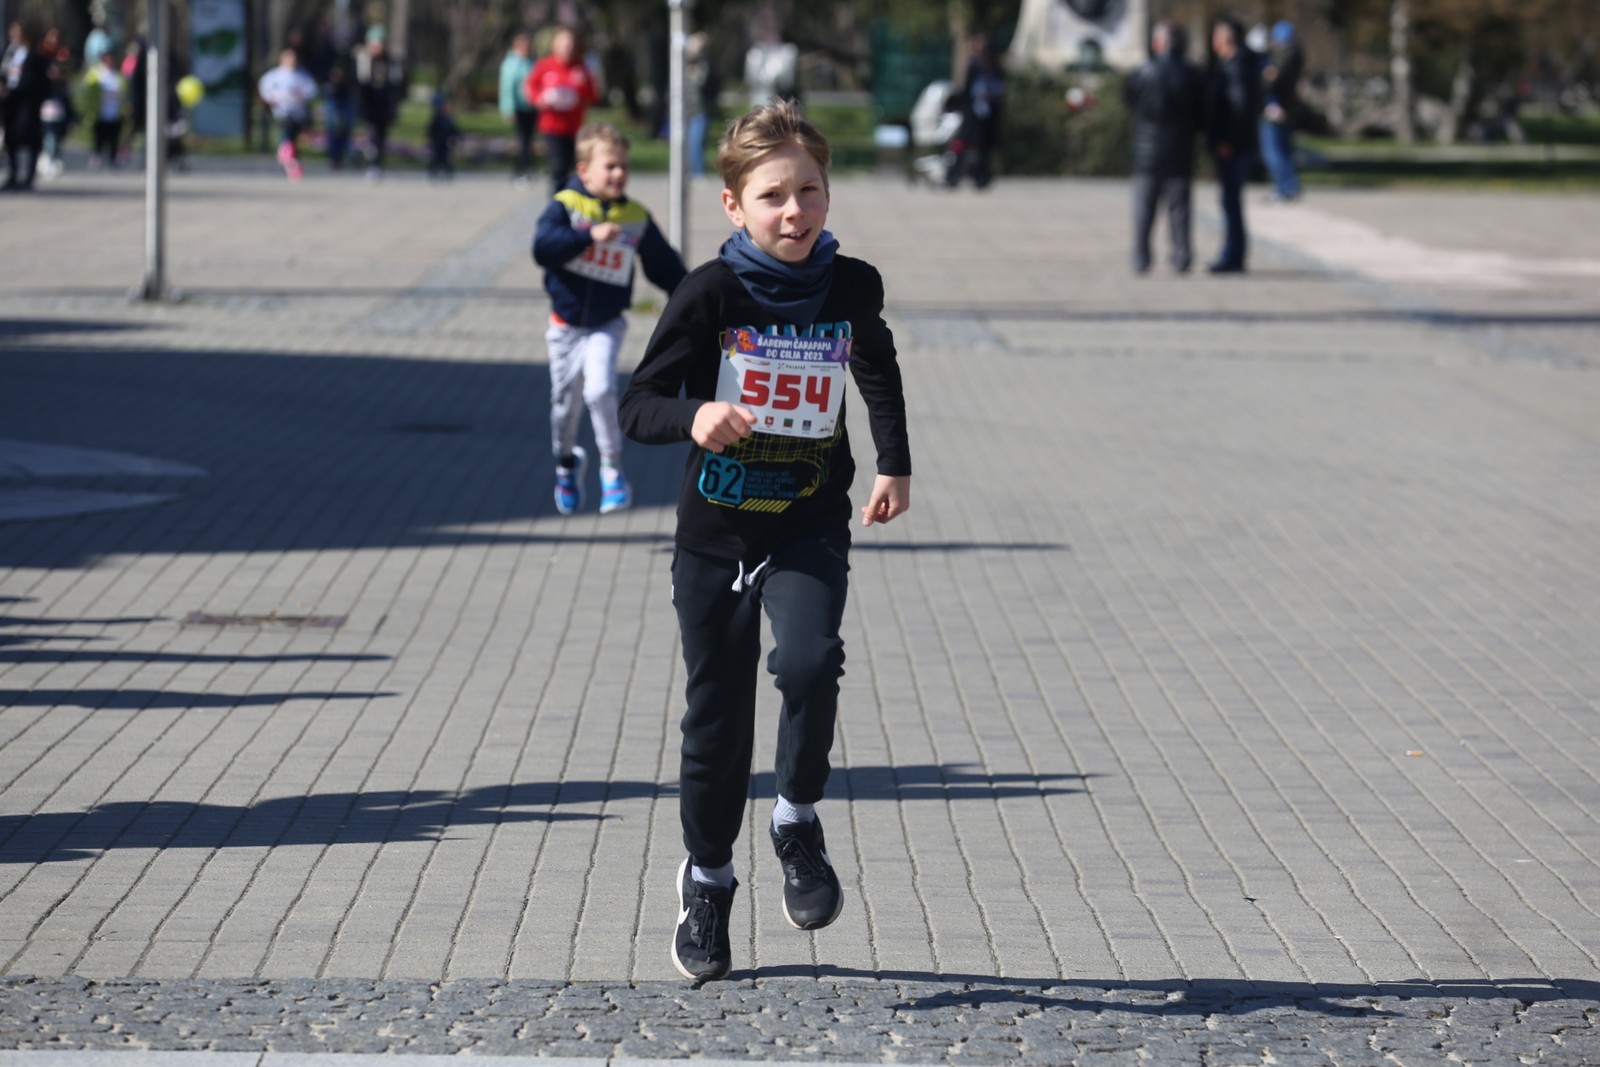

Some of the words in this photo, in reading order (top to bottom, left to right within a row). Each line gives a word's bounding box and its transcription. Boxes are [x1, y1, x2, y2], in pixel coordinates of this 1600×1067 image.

[766, 348, 777, 359] DO
[779, 349, 801, 360] CILJA
[740, 369, 831, 413] 554
[704, 457, 743, 500] 62
